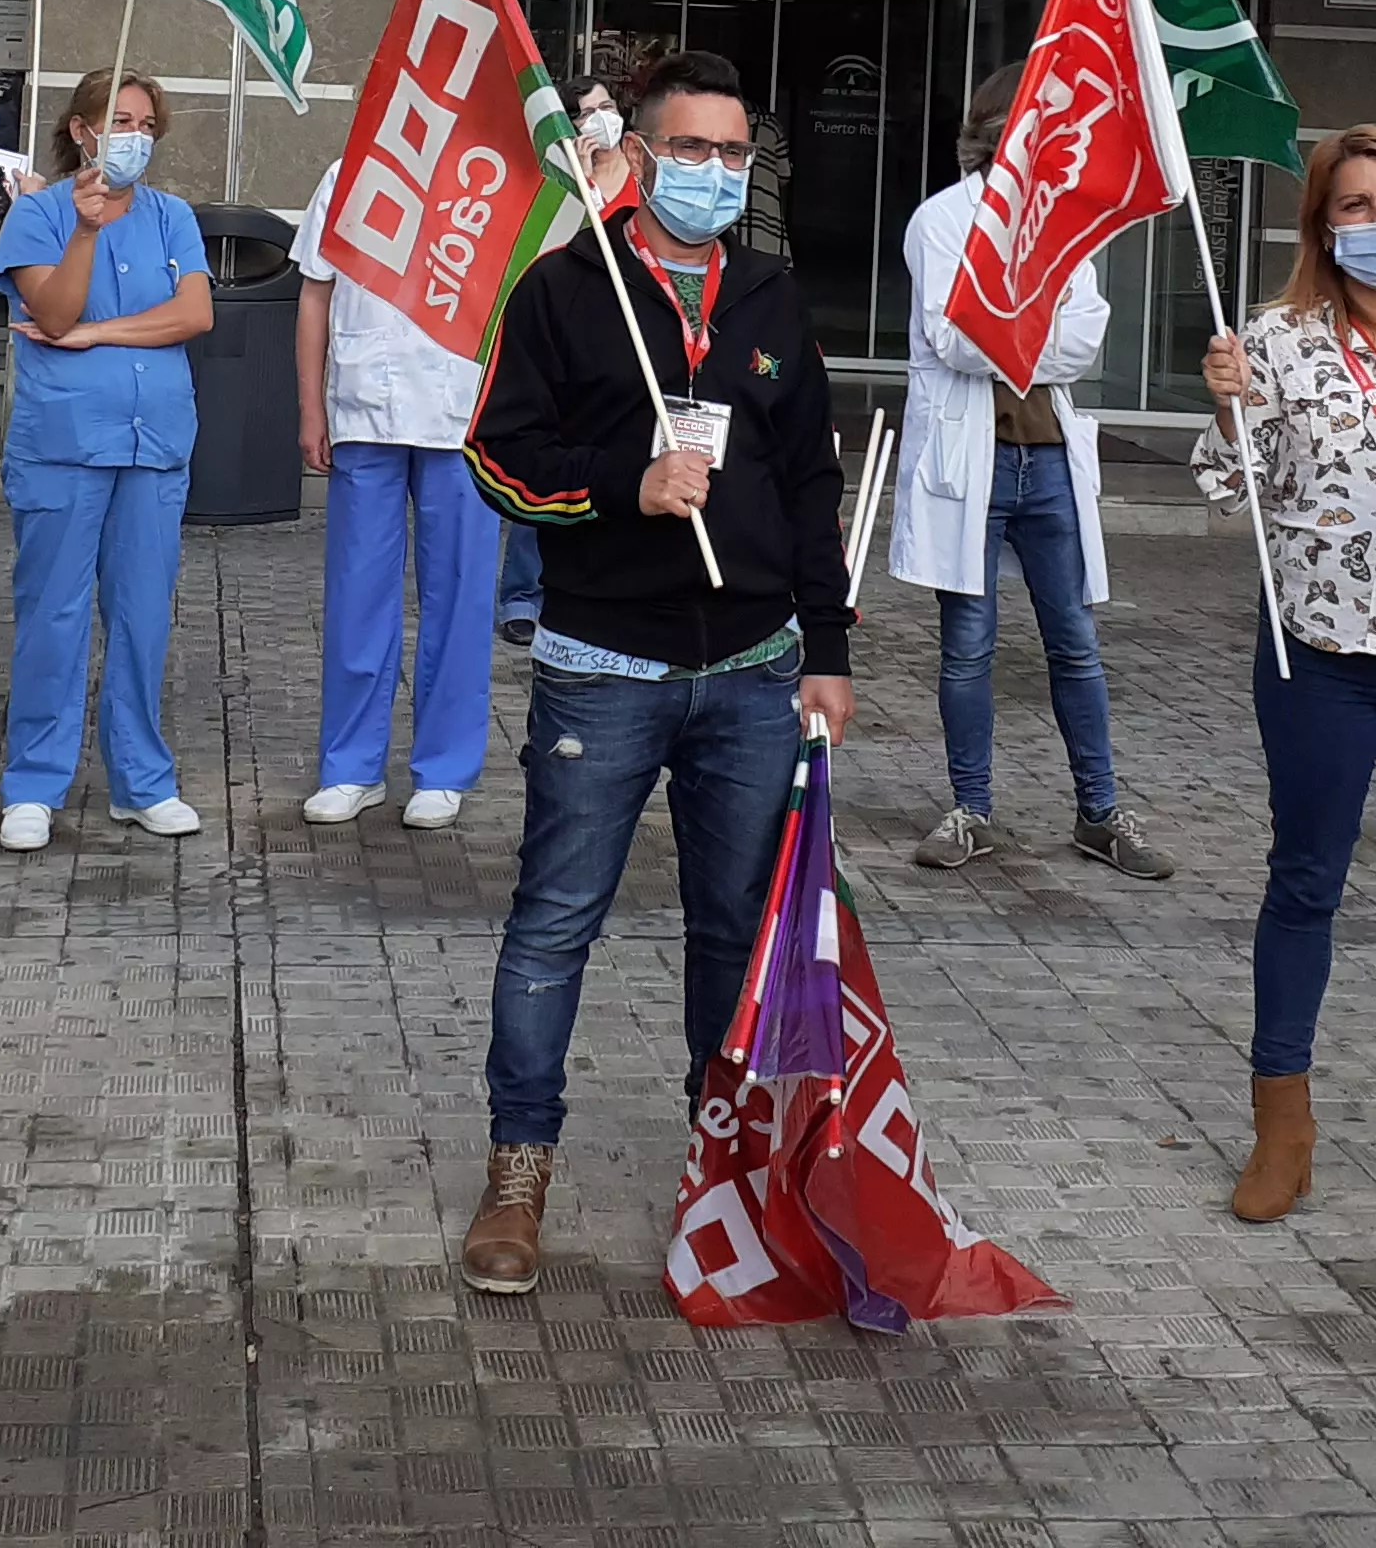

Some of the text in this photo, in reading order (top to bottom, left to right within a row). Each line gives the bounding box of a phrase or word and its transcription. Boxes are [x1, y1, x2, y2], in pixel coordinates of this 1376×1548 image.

[814, 121, 856, 136] Puerto
[591, 651, 621, 670] SEE
[626, 654, 650, 677] YOU
